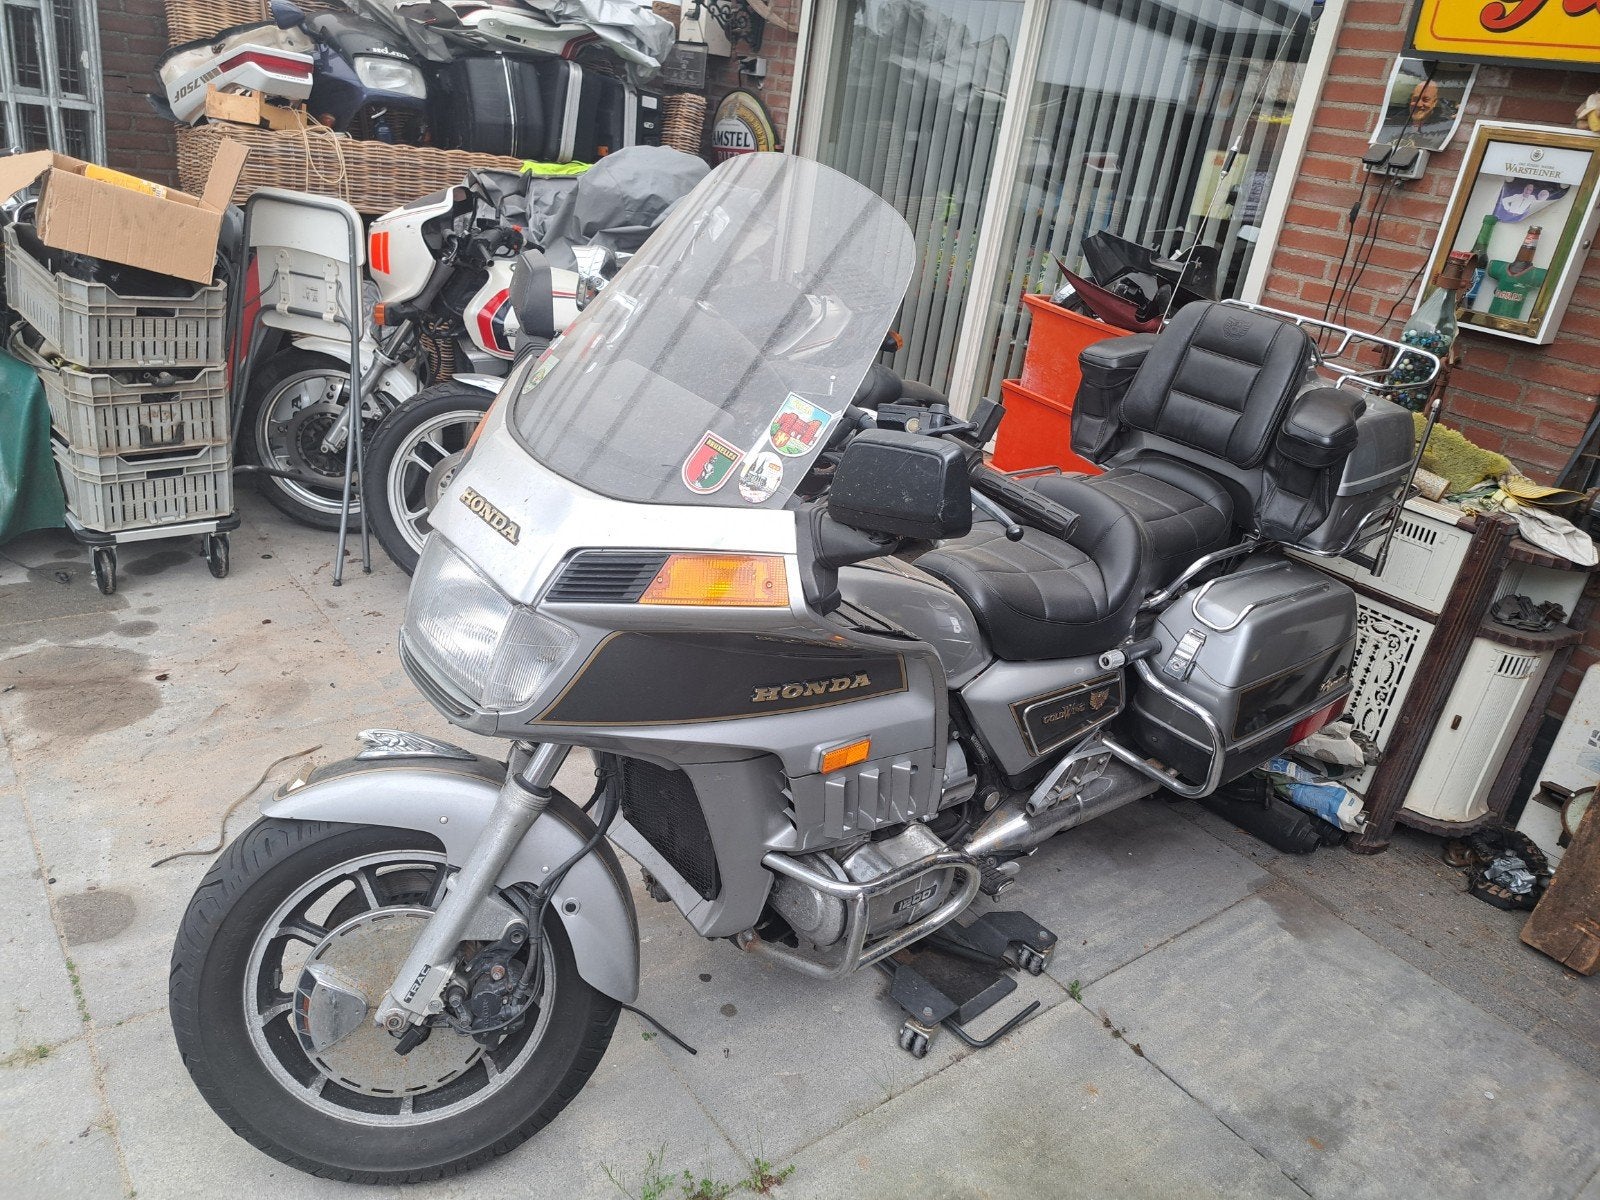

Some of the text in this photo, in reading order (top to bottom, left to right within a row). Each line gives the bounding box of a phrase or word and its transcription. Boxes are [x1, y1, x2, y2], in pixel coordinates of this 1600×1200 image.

[174, 76, 201, 104] 750F
[1505, 162, 1561, 179] WARSTEINER
[706, 438, 737, 460] BRUXELLES
[459, 486, 521, 546] HONDA
[752, 671, 872, 702] HONDA
[898, 889, 932, 911] 1200
[404, 965, 431, 1002] TRAC
